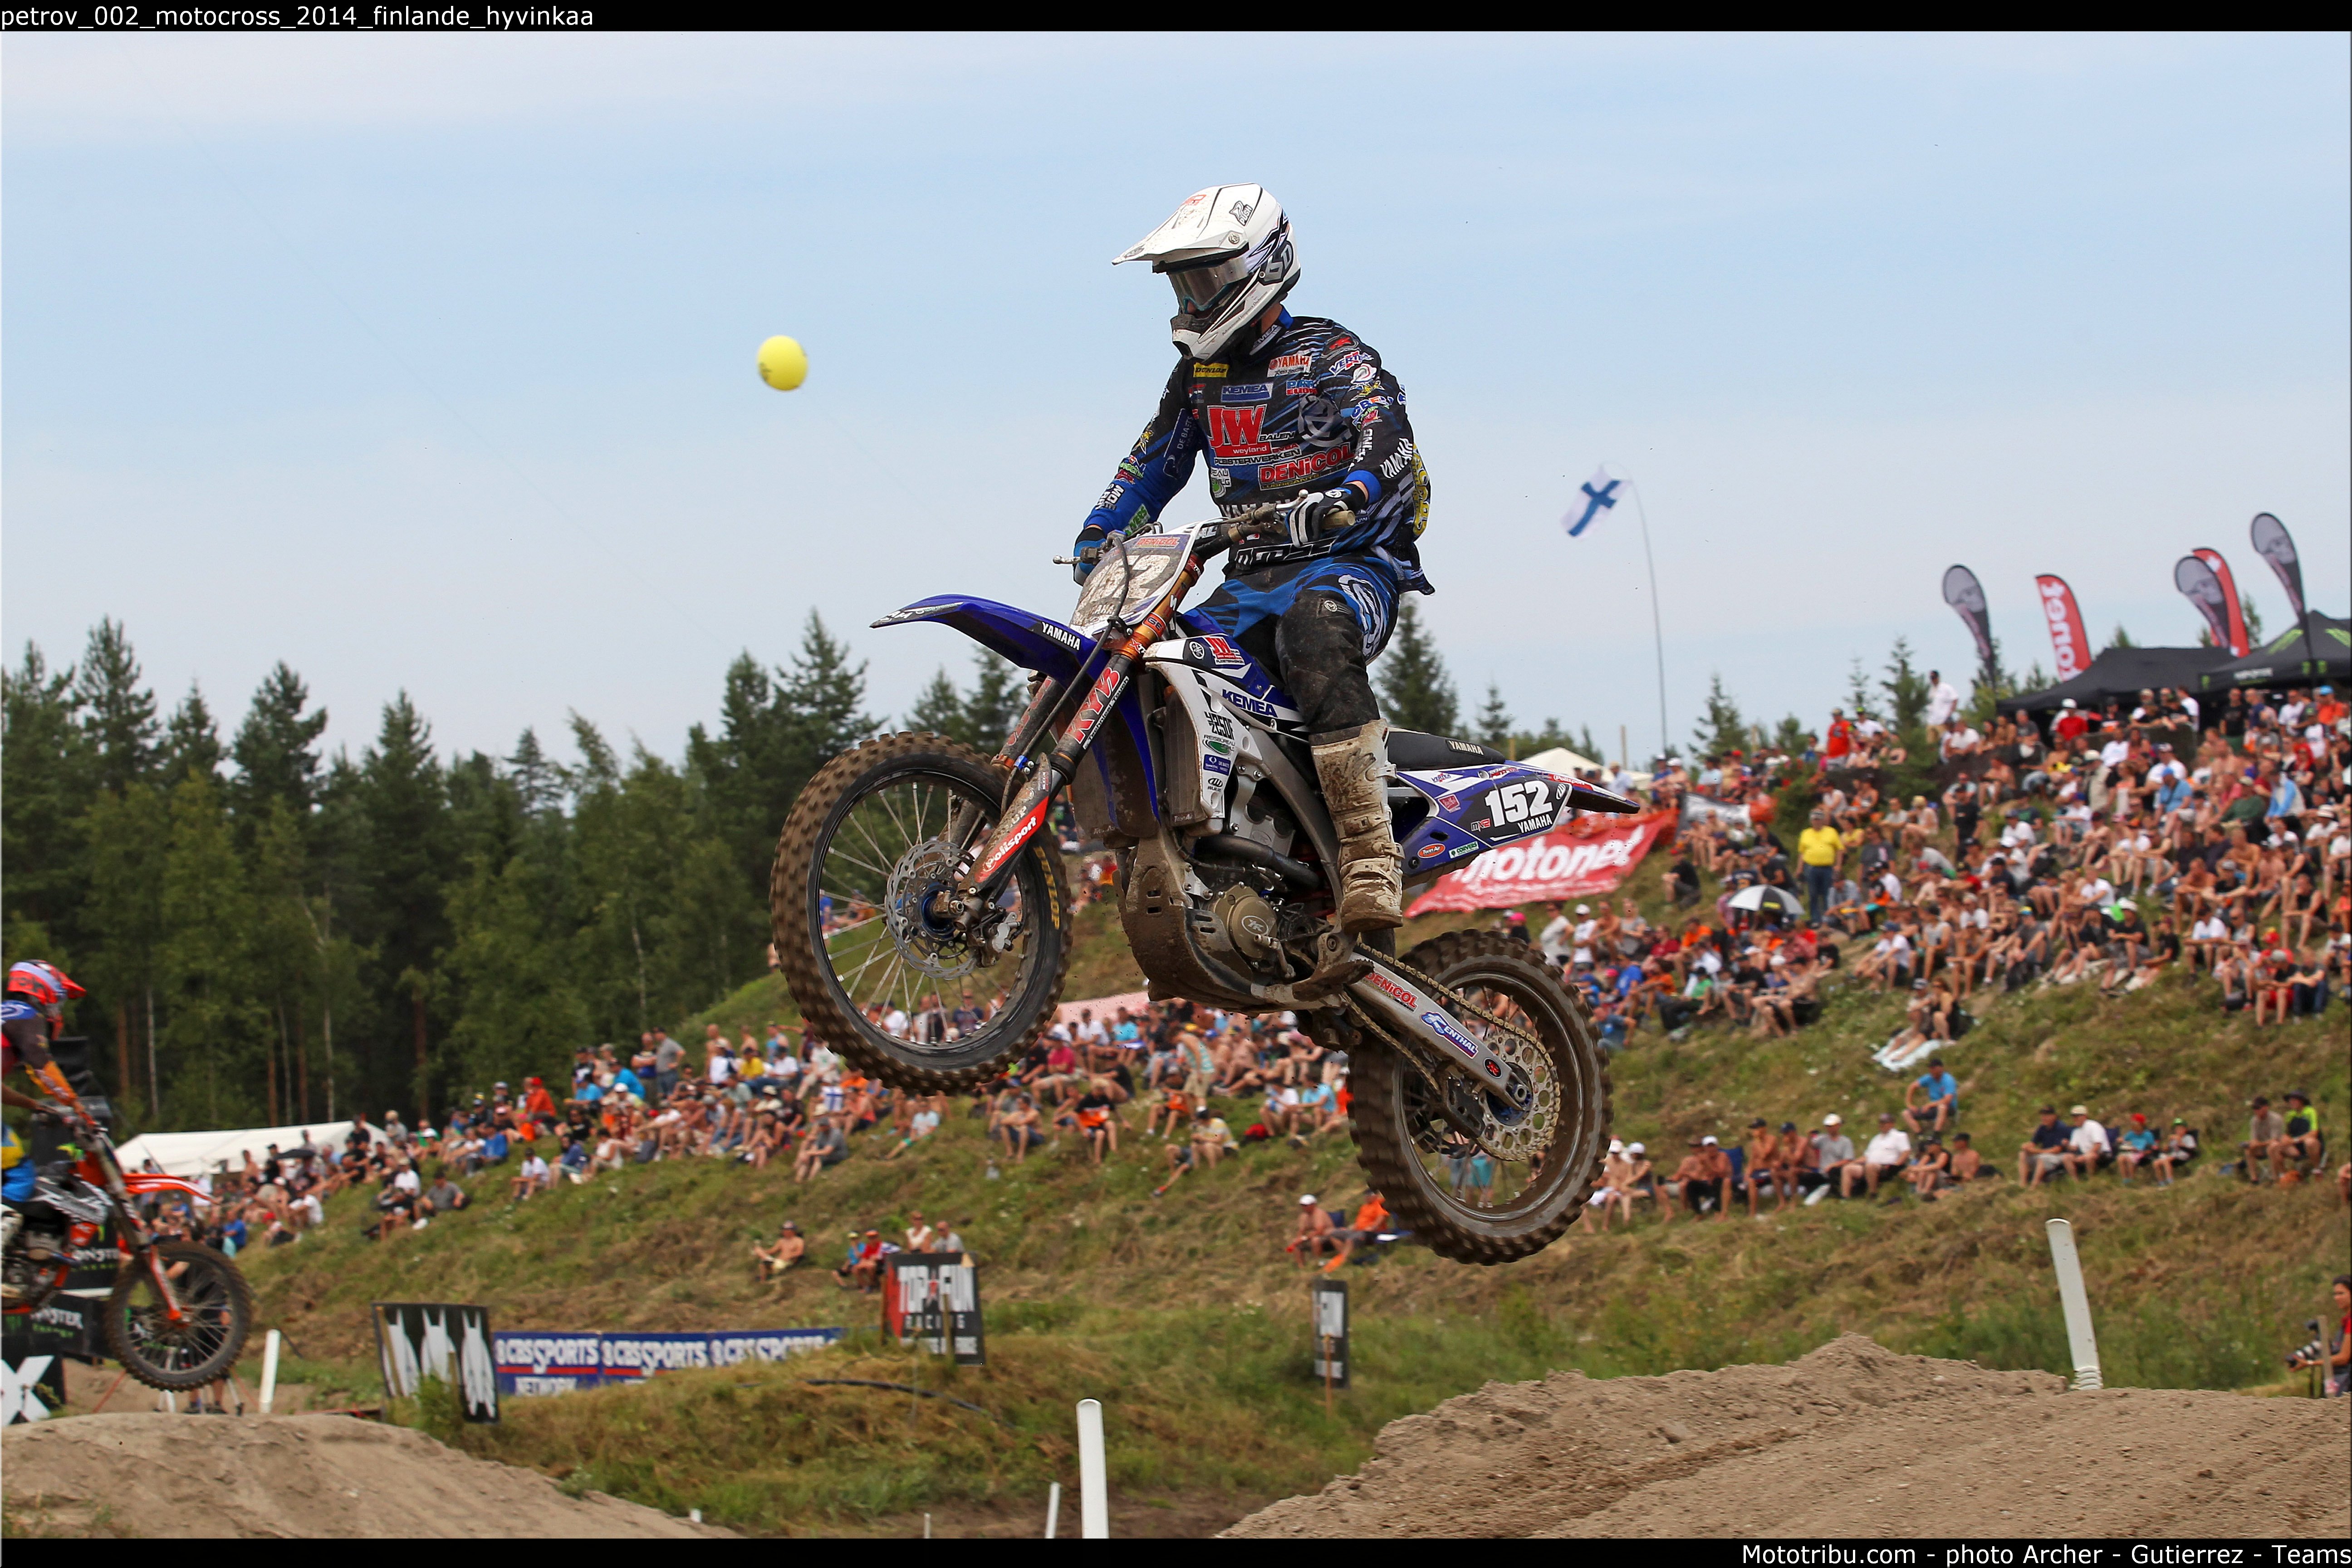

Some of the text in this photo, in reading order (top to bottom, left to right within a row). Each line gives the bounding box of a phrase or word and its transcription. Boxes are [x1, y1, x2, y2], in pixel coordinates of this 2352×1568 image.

[1239, 205, 1253, 225] PUSH
[1222, 384, 1269, 394] KEMEA
[1208, 406, 1265, 448] JW
[1259, 431, 1295, 441] BALEN
[1233, 445, 1267, 455] weyland
[1042, 622, 1081, 651] YAMAHA
[1222, 689, 1278, 718] KEMEA
[1450, 740, 1484, 756] YAMAHA
[1485, 780, 1553, 828] 152
[1518, 813, 1553, 833] YAMAHA
